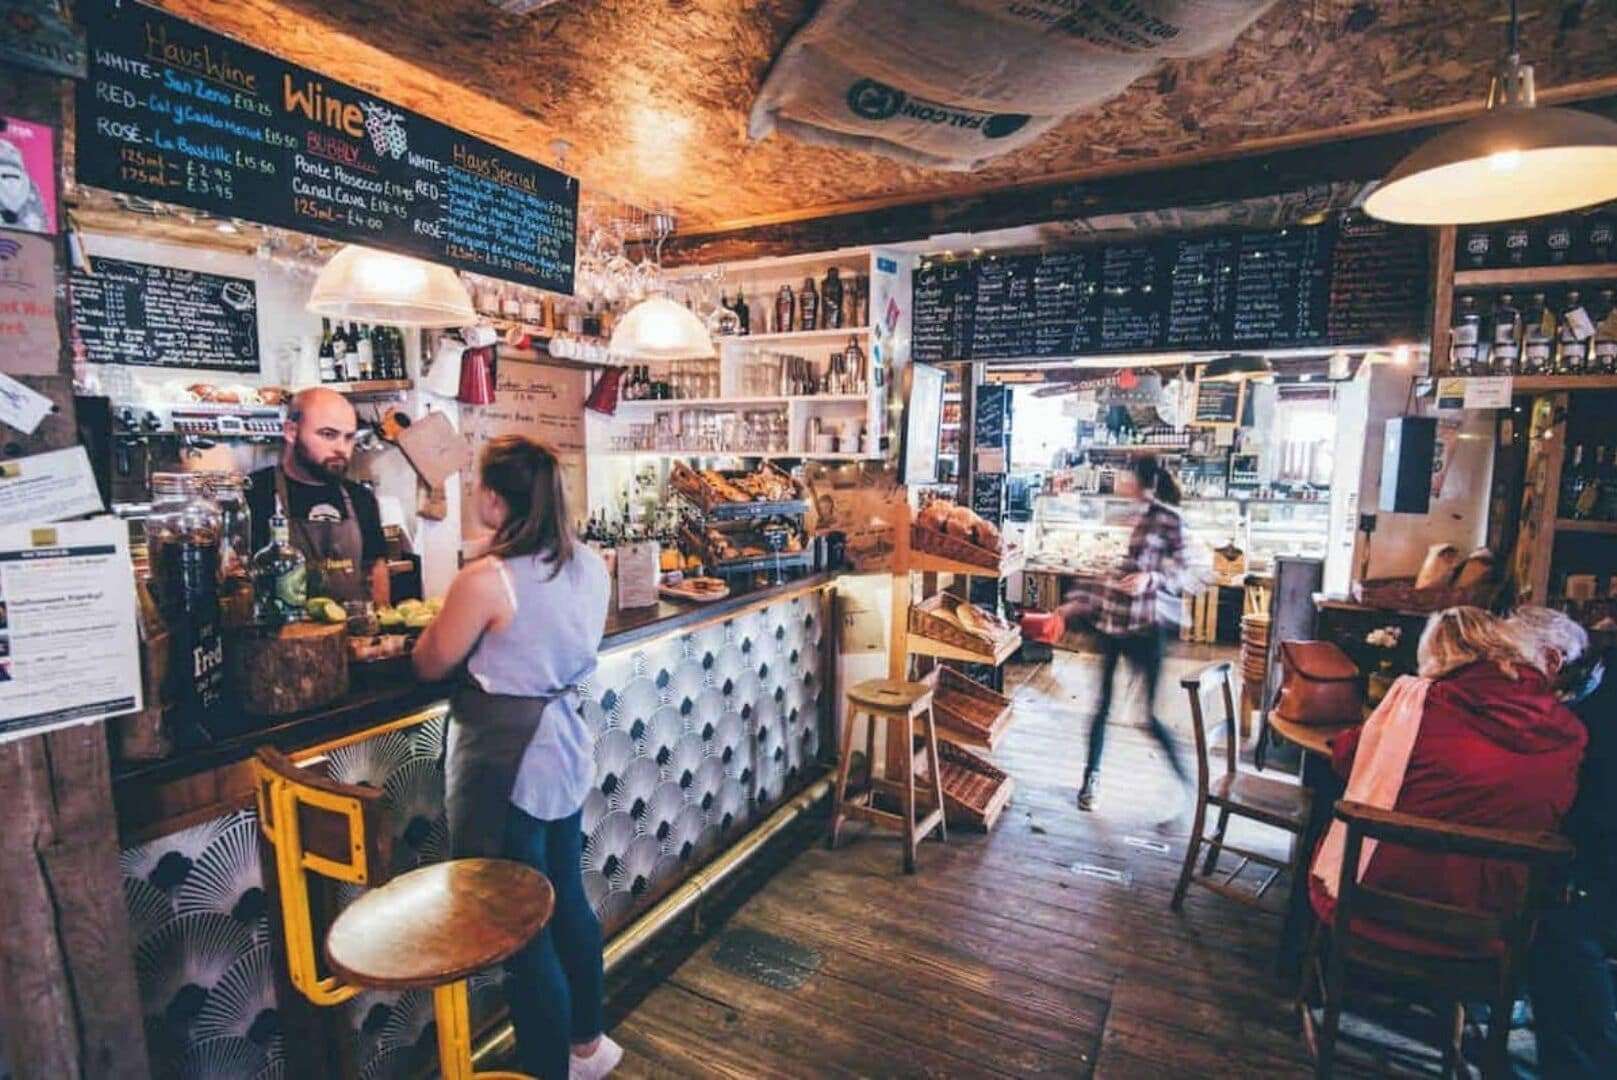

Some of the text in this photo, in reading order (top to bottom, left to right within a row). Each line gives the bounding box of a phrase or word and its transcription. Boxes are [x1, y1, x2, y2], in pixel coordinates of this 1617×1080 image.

[283, 73, 365, 138] Wine
[902, 103, 984, 129] FALCON
[293, 177, 334, 201] Canal
[335, 187, 367, 208] Cava
[193, 637, 222, 678] Fred
